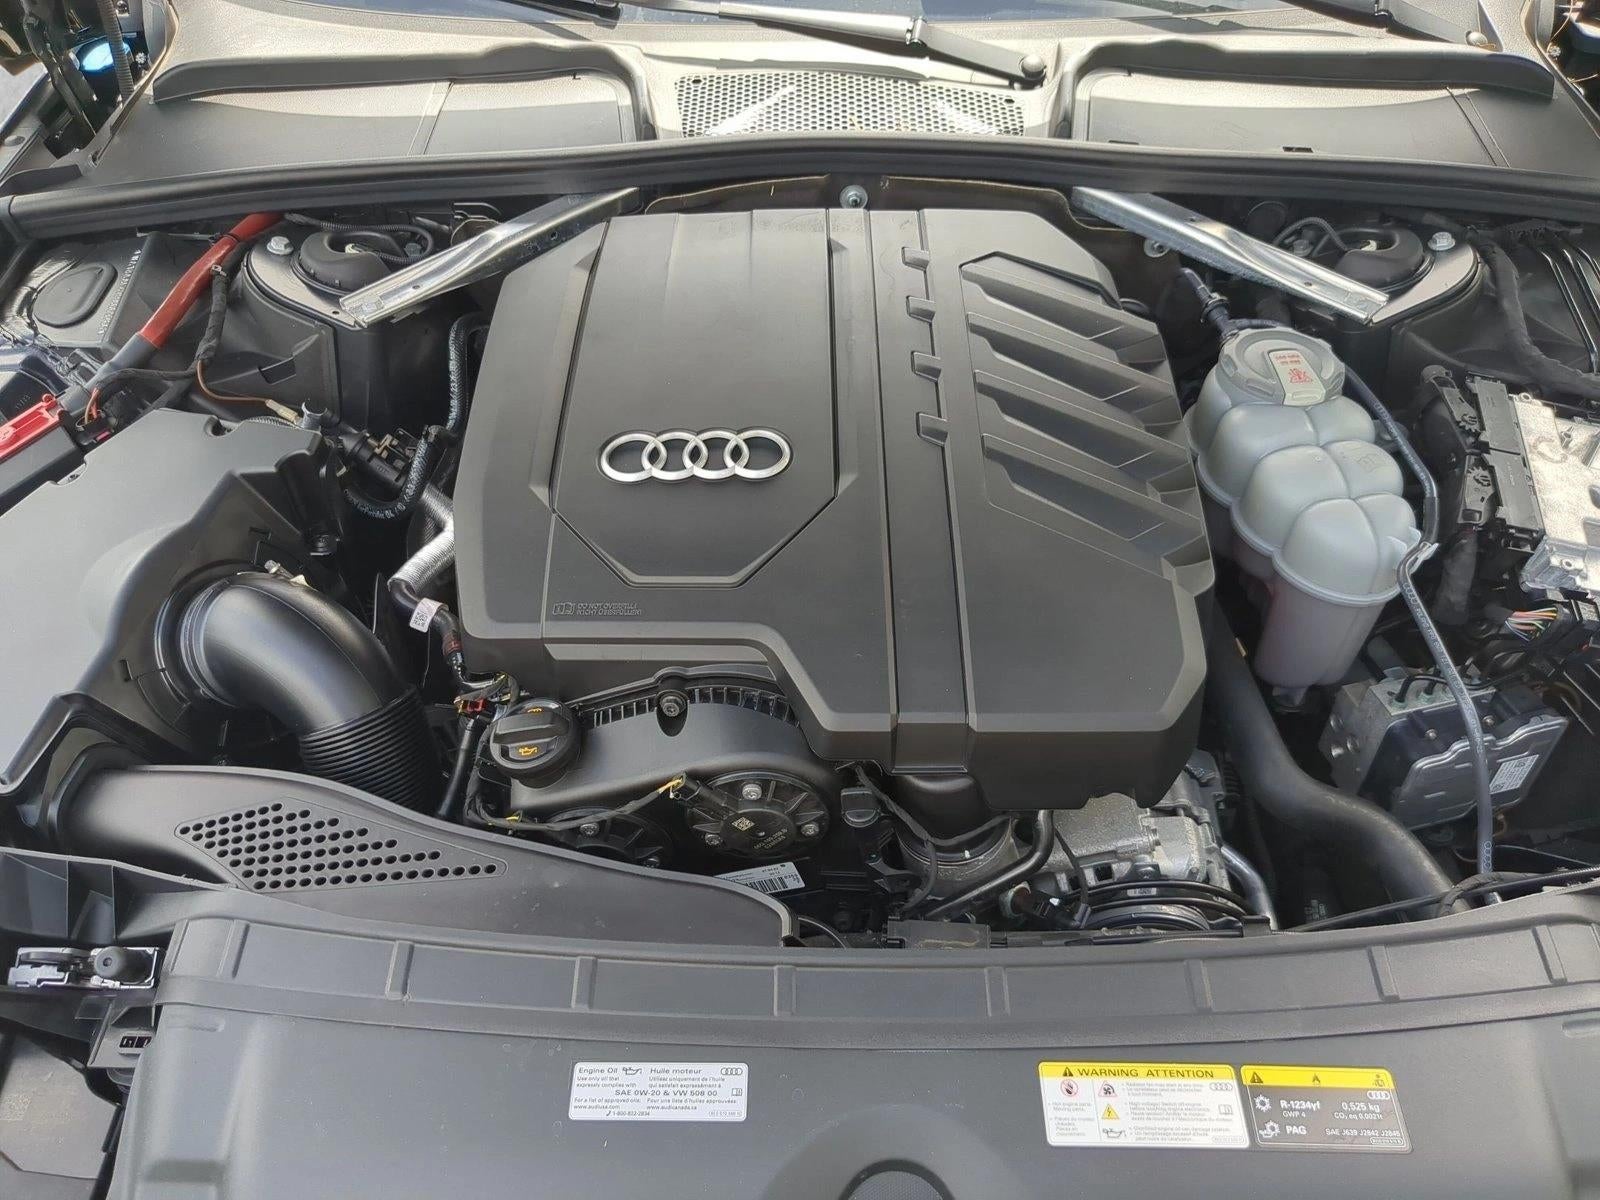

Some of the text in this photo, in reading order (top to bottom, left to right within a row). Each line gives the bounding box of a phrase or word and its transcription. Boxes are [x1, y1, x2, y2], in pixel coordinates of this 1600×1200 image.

[1077, 1068, 1214, 1078] WARNING ATTENTION
[1280, 1100, 1320, 1111] R-1234yf
[1368, 1102, 1380, 1112] kg
[1286, 1125, 1307, 1135] PAG
